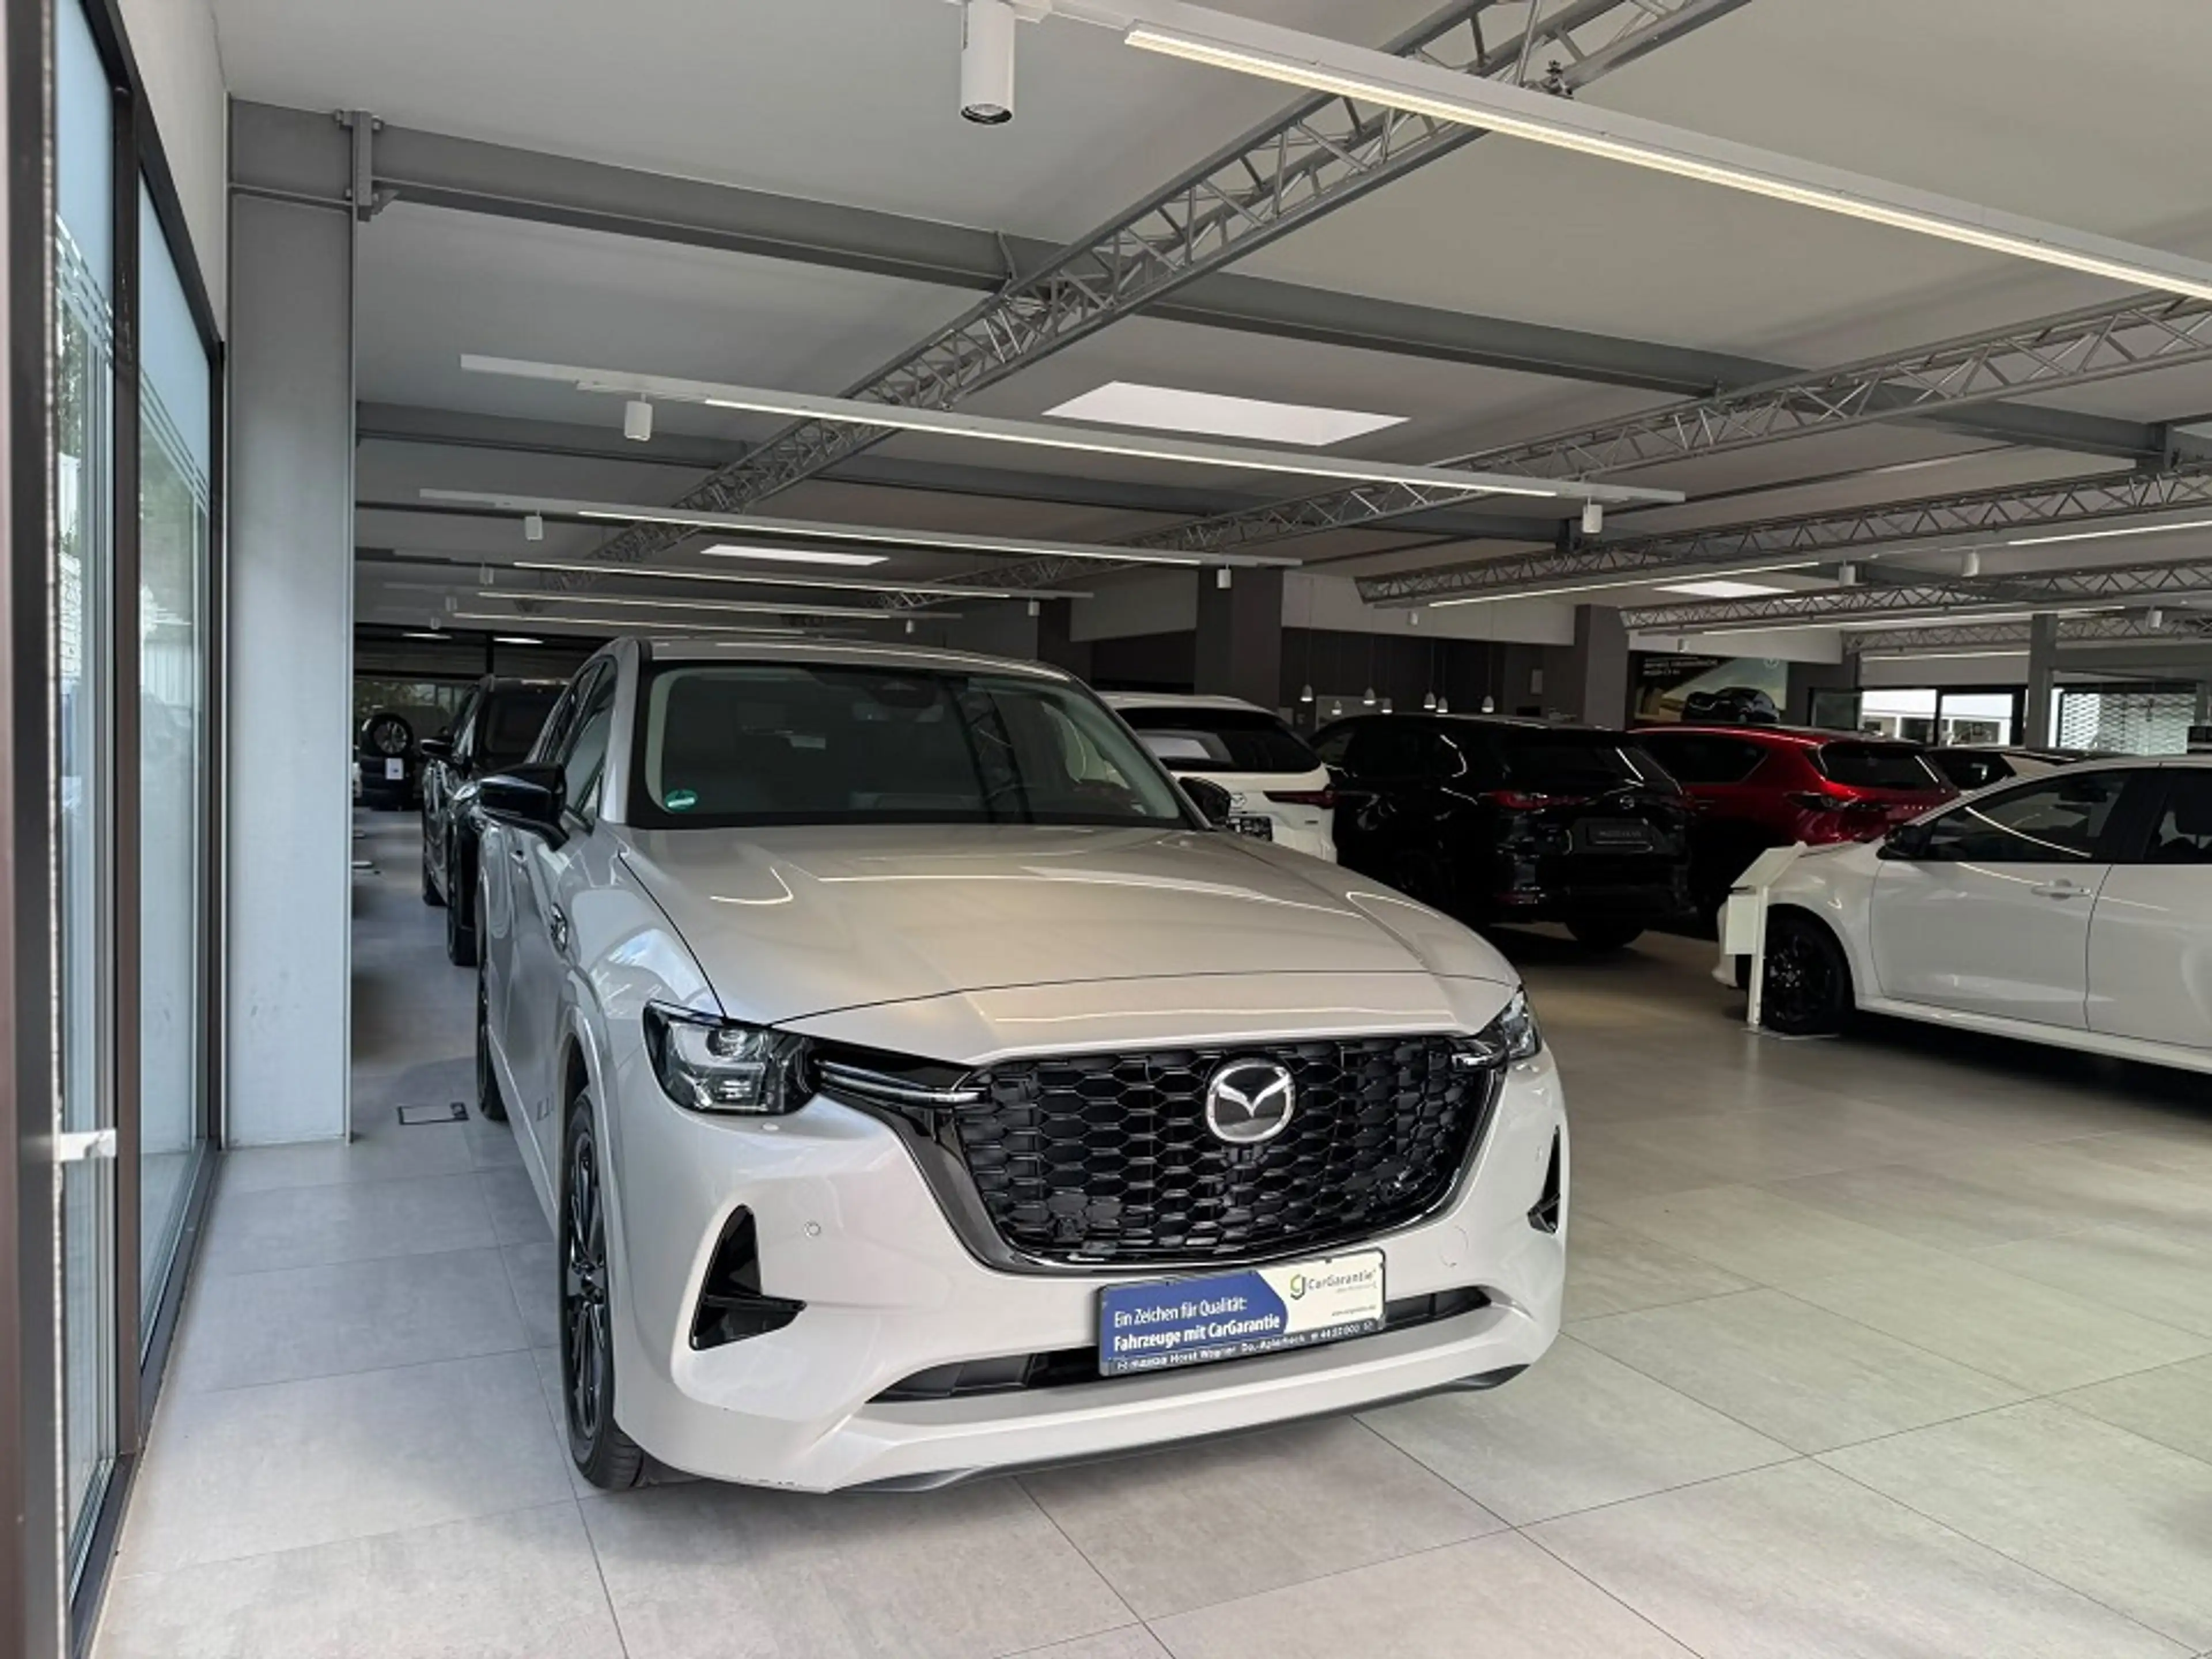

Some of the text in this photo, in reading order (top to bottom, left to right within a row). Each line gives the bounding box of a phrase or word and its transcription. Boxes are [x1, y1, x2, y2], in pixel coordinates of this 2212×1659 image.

[1115, 1296, 1248, 1328] Ein Zeichen für Qualität:
[1114, 1313, 1281, 1352] Fahrzeuge mit CarGarantie
